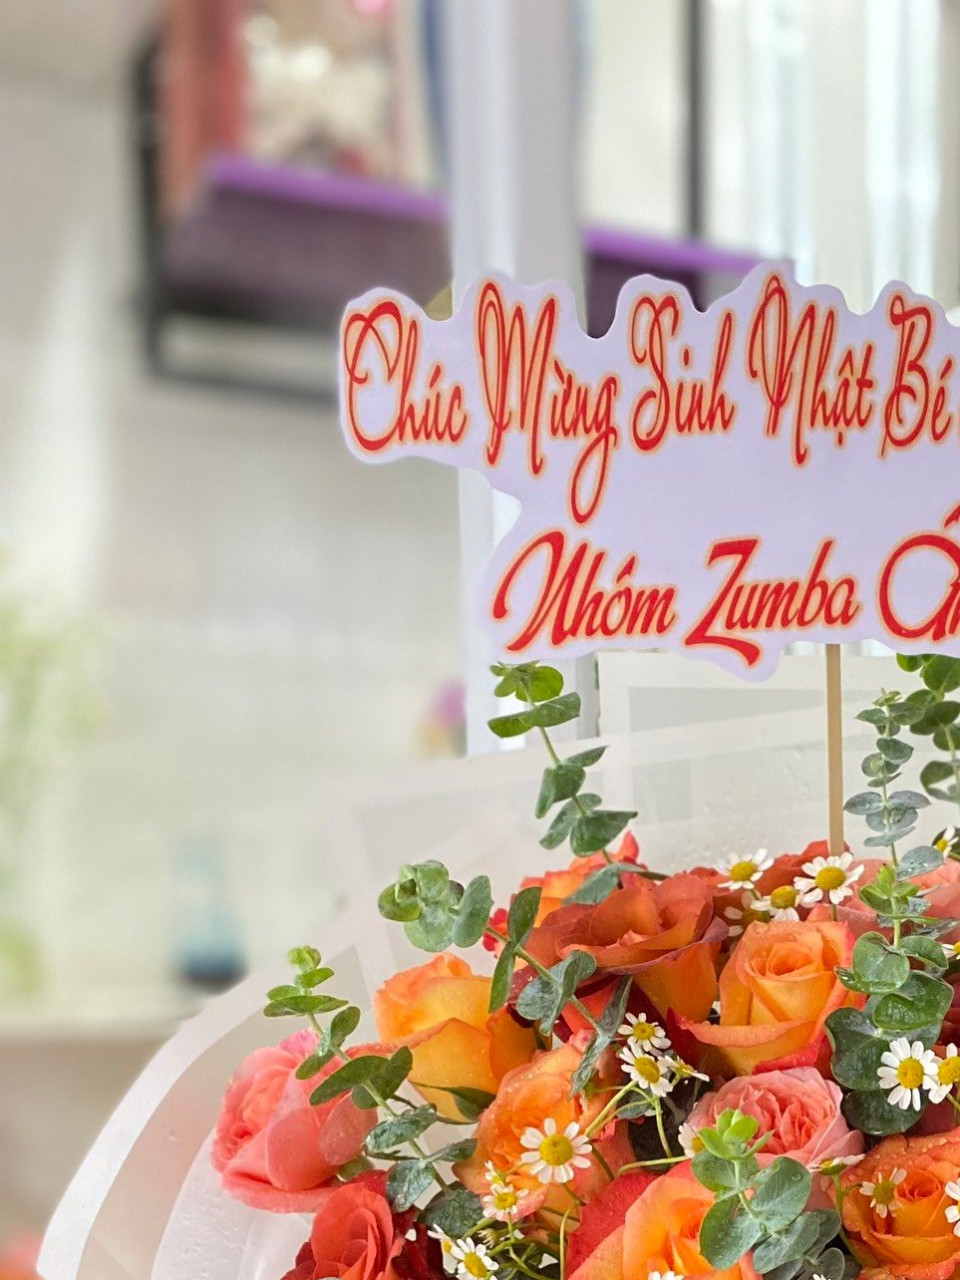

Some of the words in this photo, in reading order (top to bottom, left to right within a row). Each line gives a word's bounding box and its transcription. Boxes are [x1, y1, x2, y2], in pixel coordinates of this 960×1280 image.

[345, 300, 469, 454] Chúc
[477, 281, 621, 527] Mừng
[631, 295, 737, 454] Sinh
[748, 275, 877, 467] Nhật
[881, 294, 955, 457] Bé
[492, 530, 678, 654] Nhóm
[684, 538, 858, 668] Zumba
